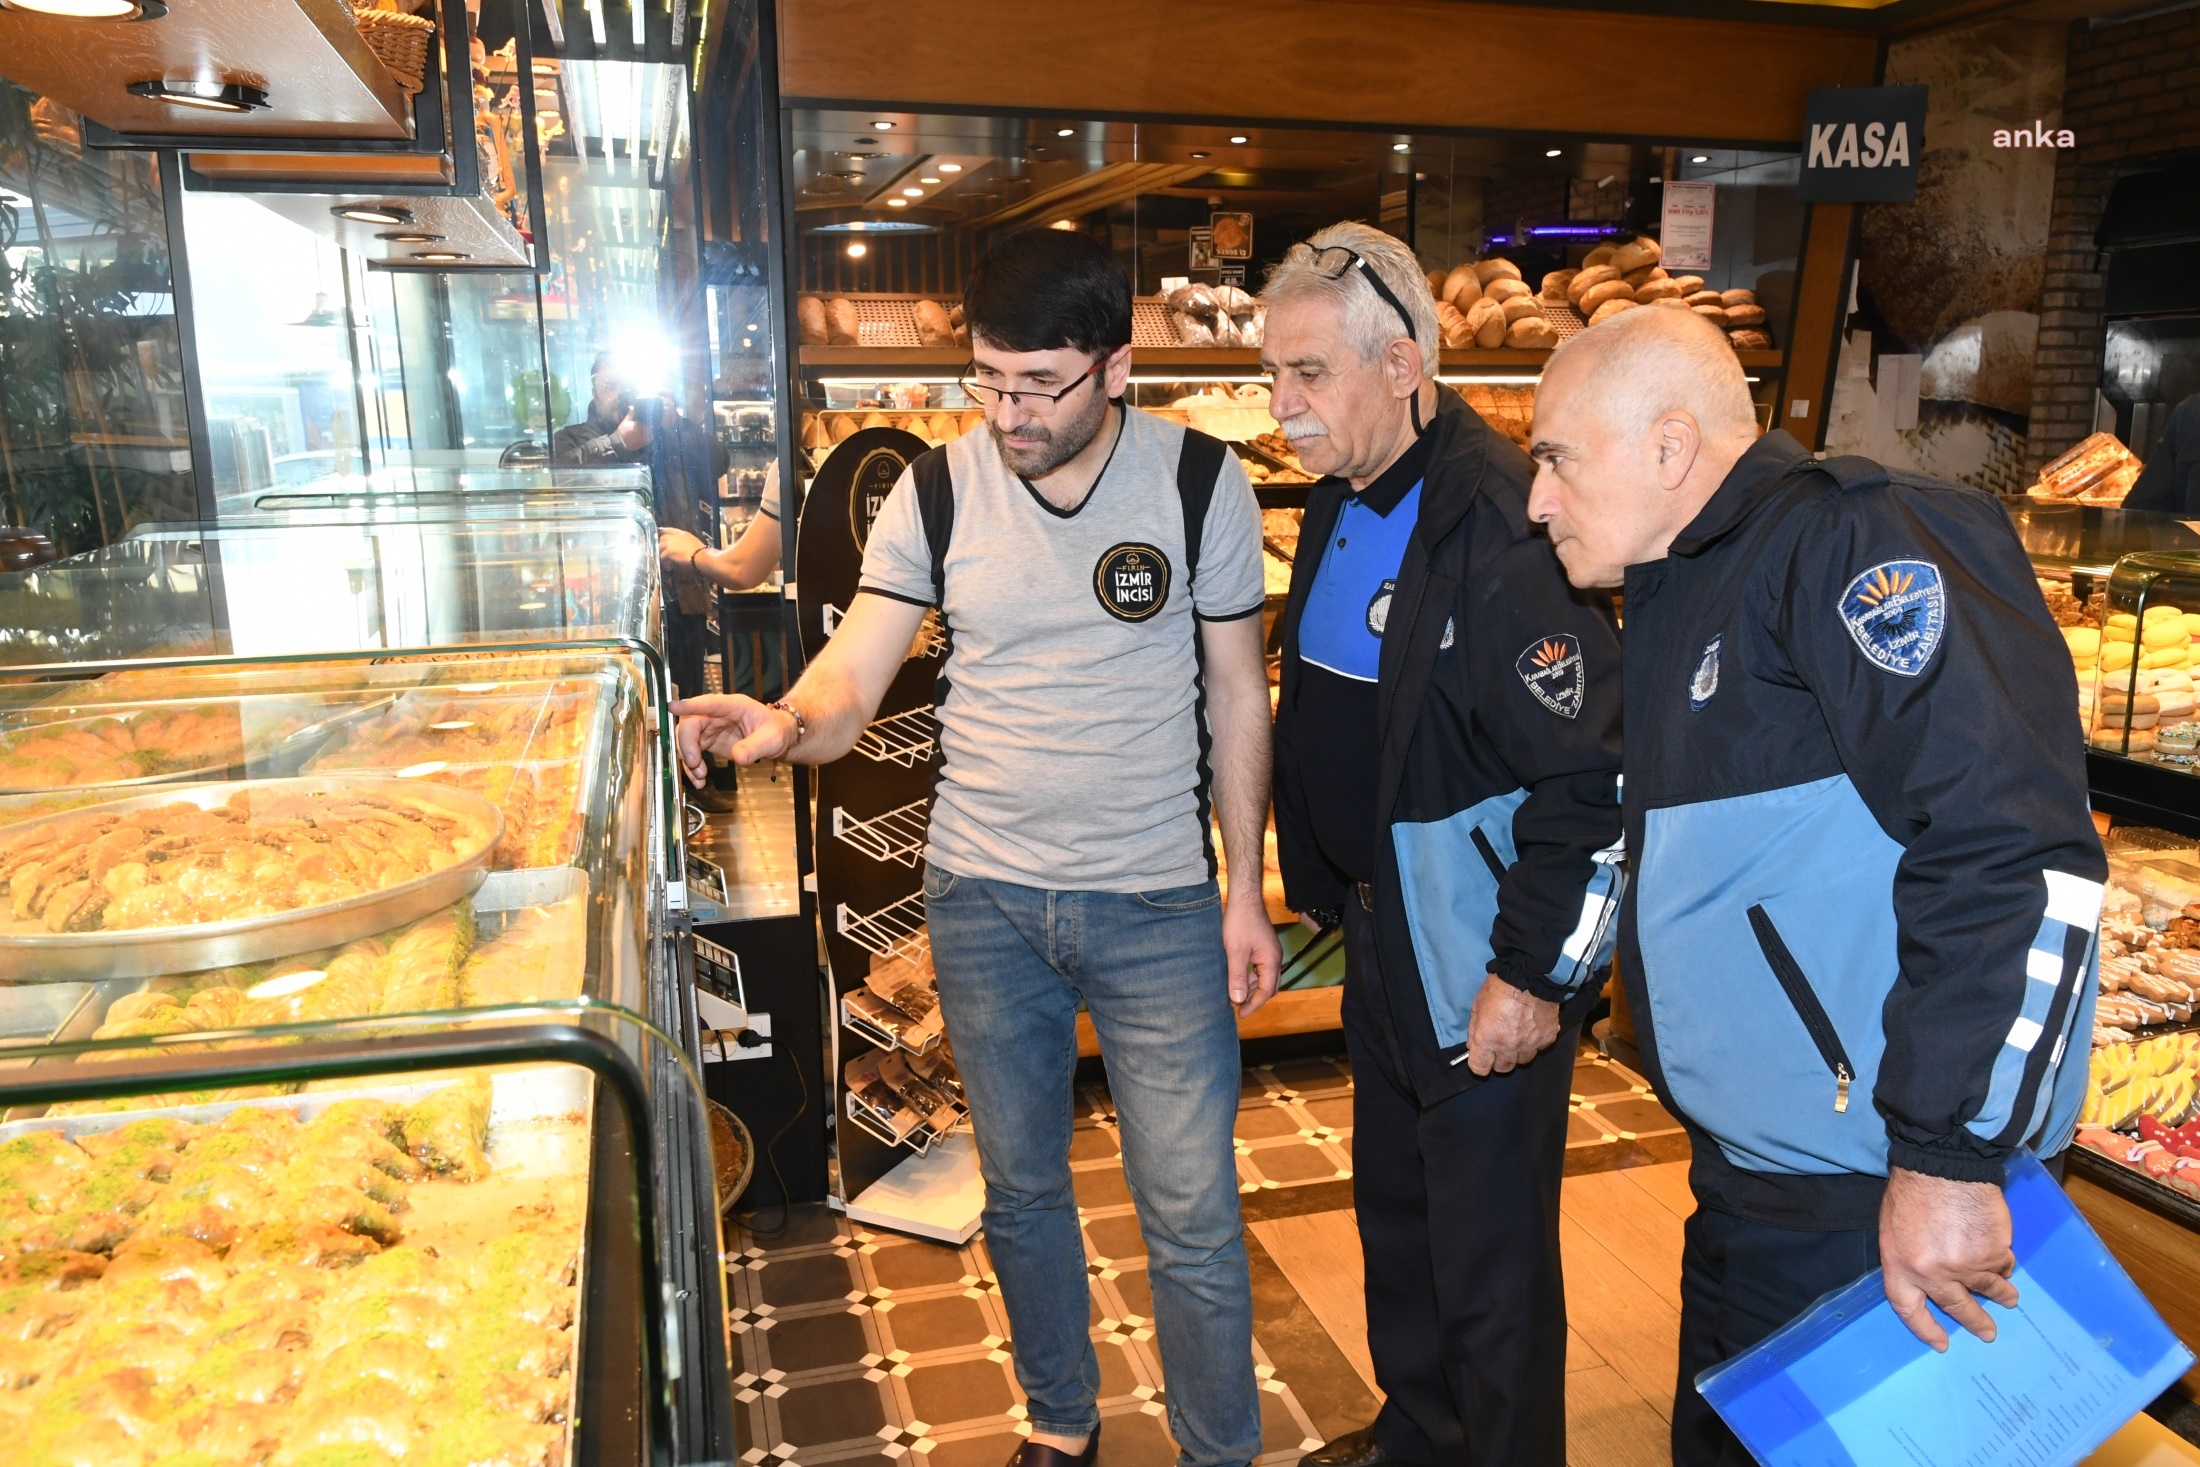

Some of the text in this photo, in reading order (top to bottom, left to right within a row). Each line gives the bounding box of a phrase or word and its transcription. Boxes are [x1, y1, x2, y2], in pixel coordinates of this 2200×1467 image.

[1808, 121, 1910, 168] KASA
[1115, 571, 1152, 587] İZMİR
[1116, 586, 1153, 602] İNCİSİ
[1530, 681, 1570, 714] BELEDİYE
